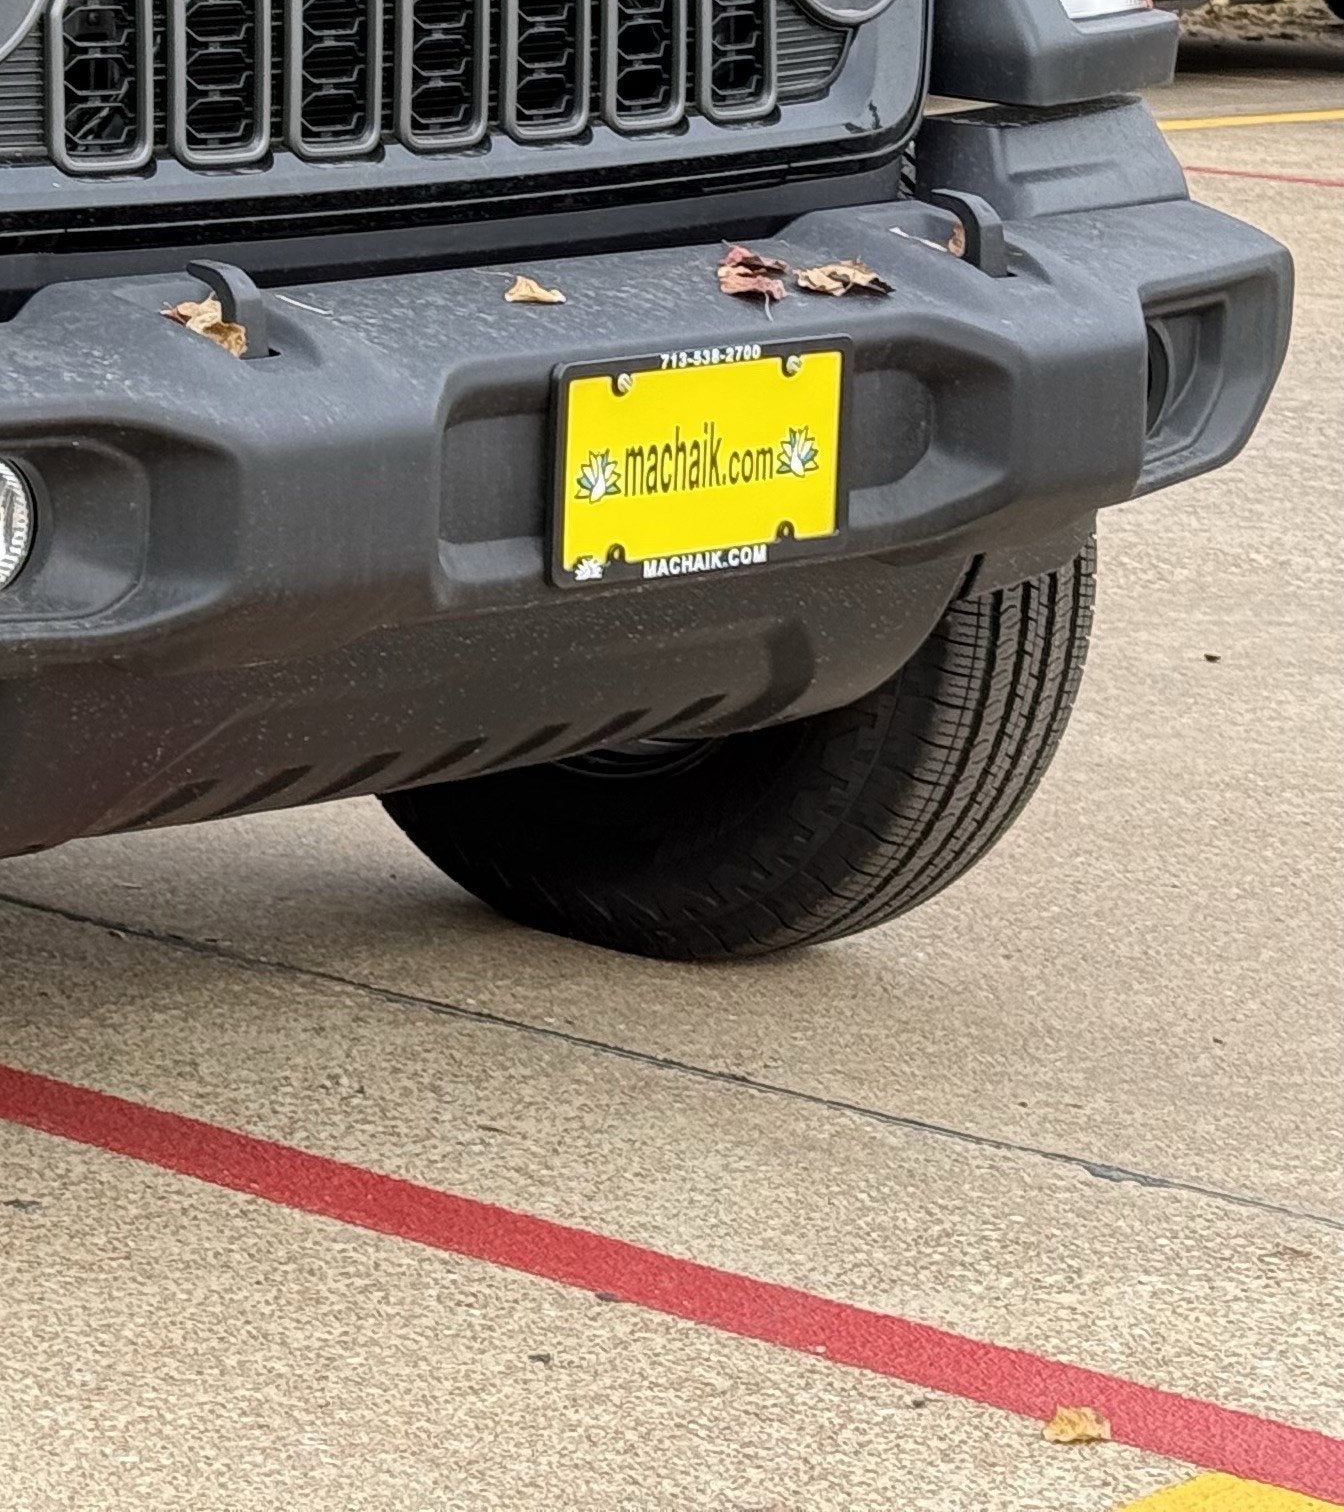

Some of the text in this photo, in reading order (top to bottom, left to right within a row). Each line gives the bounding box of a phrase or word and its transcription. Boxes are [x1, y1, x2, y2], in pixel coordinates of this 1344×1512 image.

[660, 343, 762, 370] 713-538-2700
[623, 421, 774, 498] machaik.com
[642, 543, 768, 579] MACHAIK.COM
